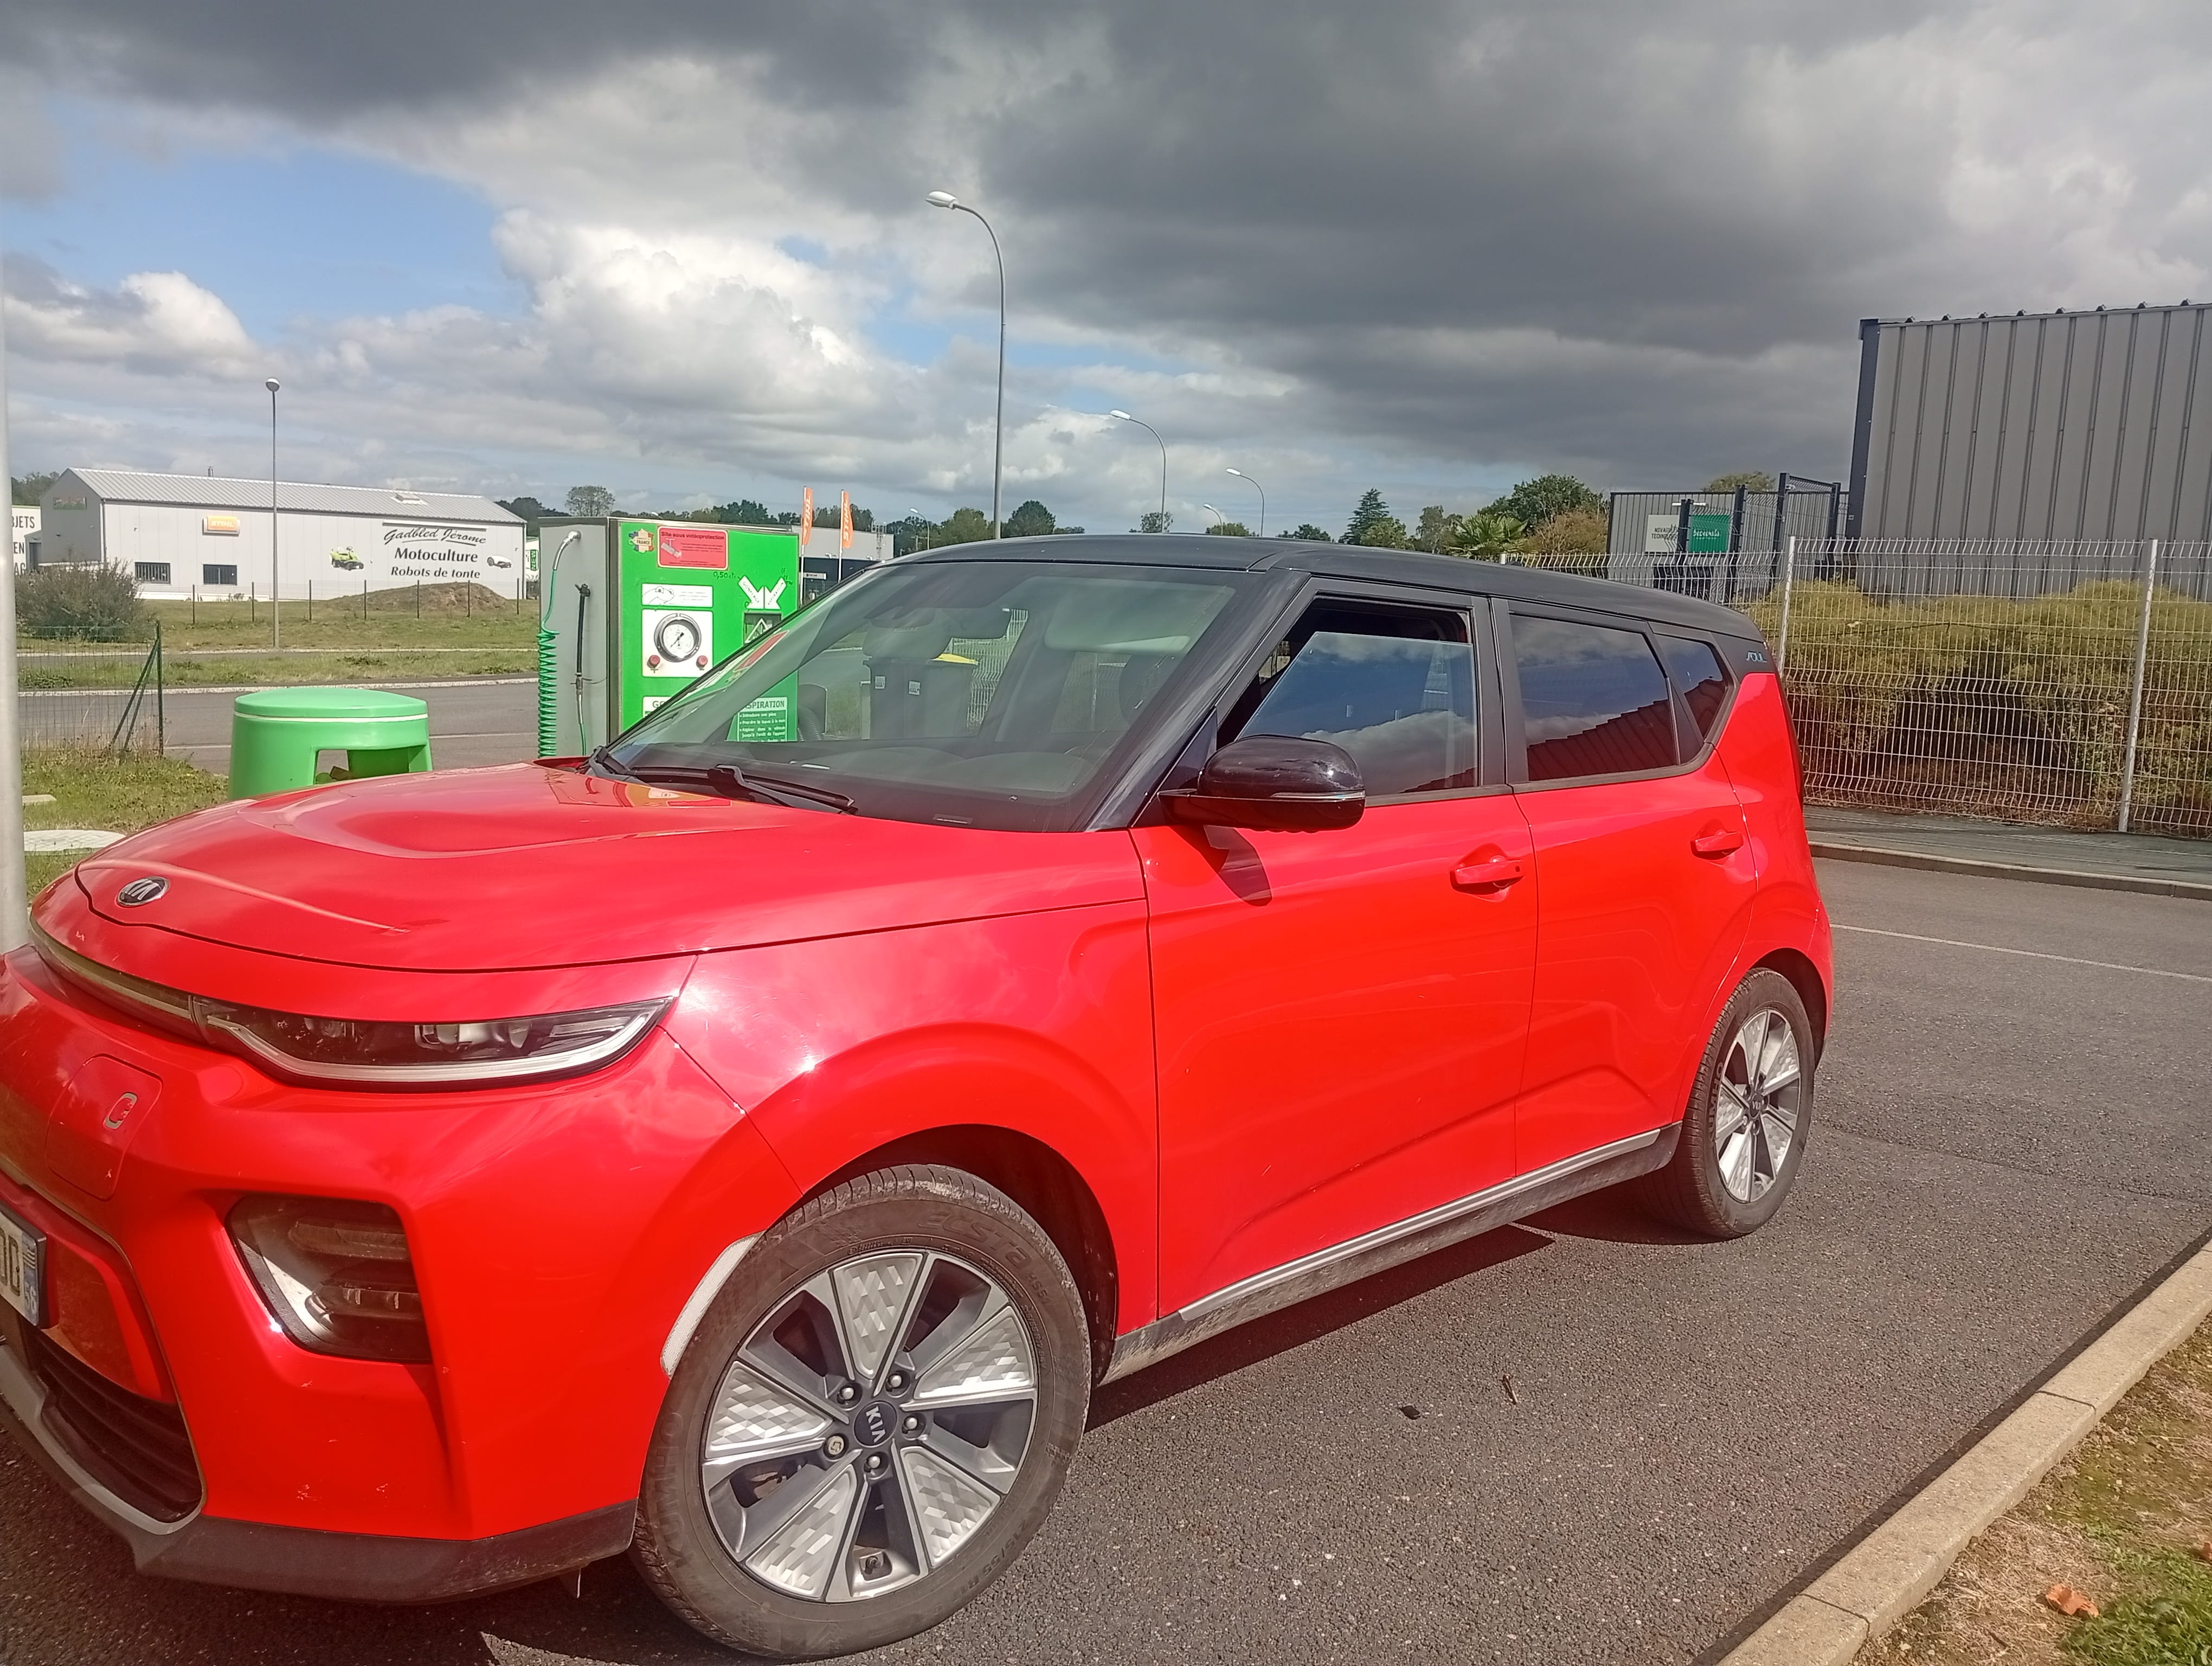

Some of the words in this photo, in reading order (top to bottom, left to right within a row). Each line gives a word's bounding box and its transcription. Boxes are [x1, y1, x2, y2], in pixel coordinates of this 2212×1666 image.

[383, 527, 439, 545] Gadbled
[394, 547, 478, 563] Motoculture
[391, 566, 430, 578] Robots
[434, 567, 448, 578] de
[452, 569, 480, 579] tonte
[865, 1405, 886, 1443] KIA
